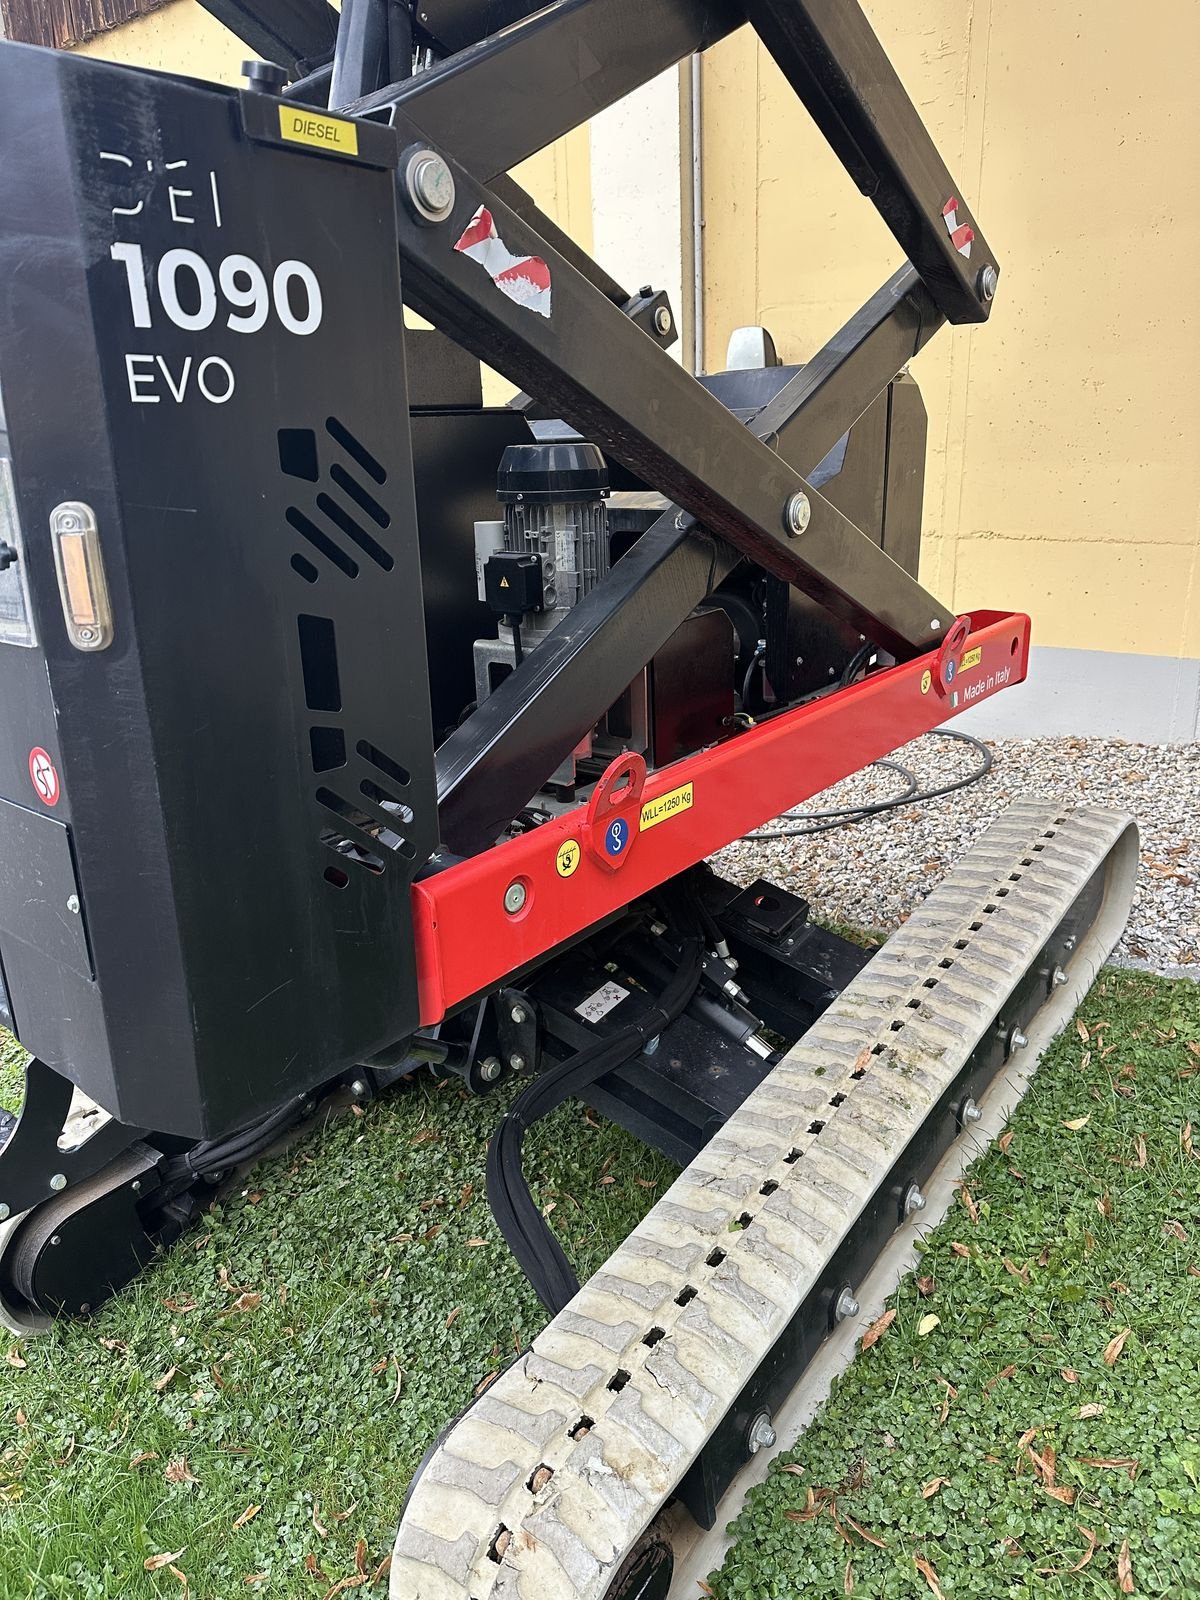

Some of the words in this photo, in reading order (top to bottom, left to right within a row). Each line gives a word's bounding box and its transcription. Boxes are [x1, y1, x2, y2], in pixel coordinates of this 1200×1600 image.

[293, 118, 340, 143] DIESEL
[110, 242, 323, 336] 1090
[125, 353, 235, 404] EVO
[963, 680, 985, 702] Made
[986, 675, 994, 690] in
[994, 666, 1011, 688] Italy
[641, 796, 680, 823] WLL=1250
[682, 792, 691, 804] Kg
